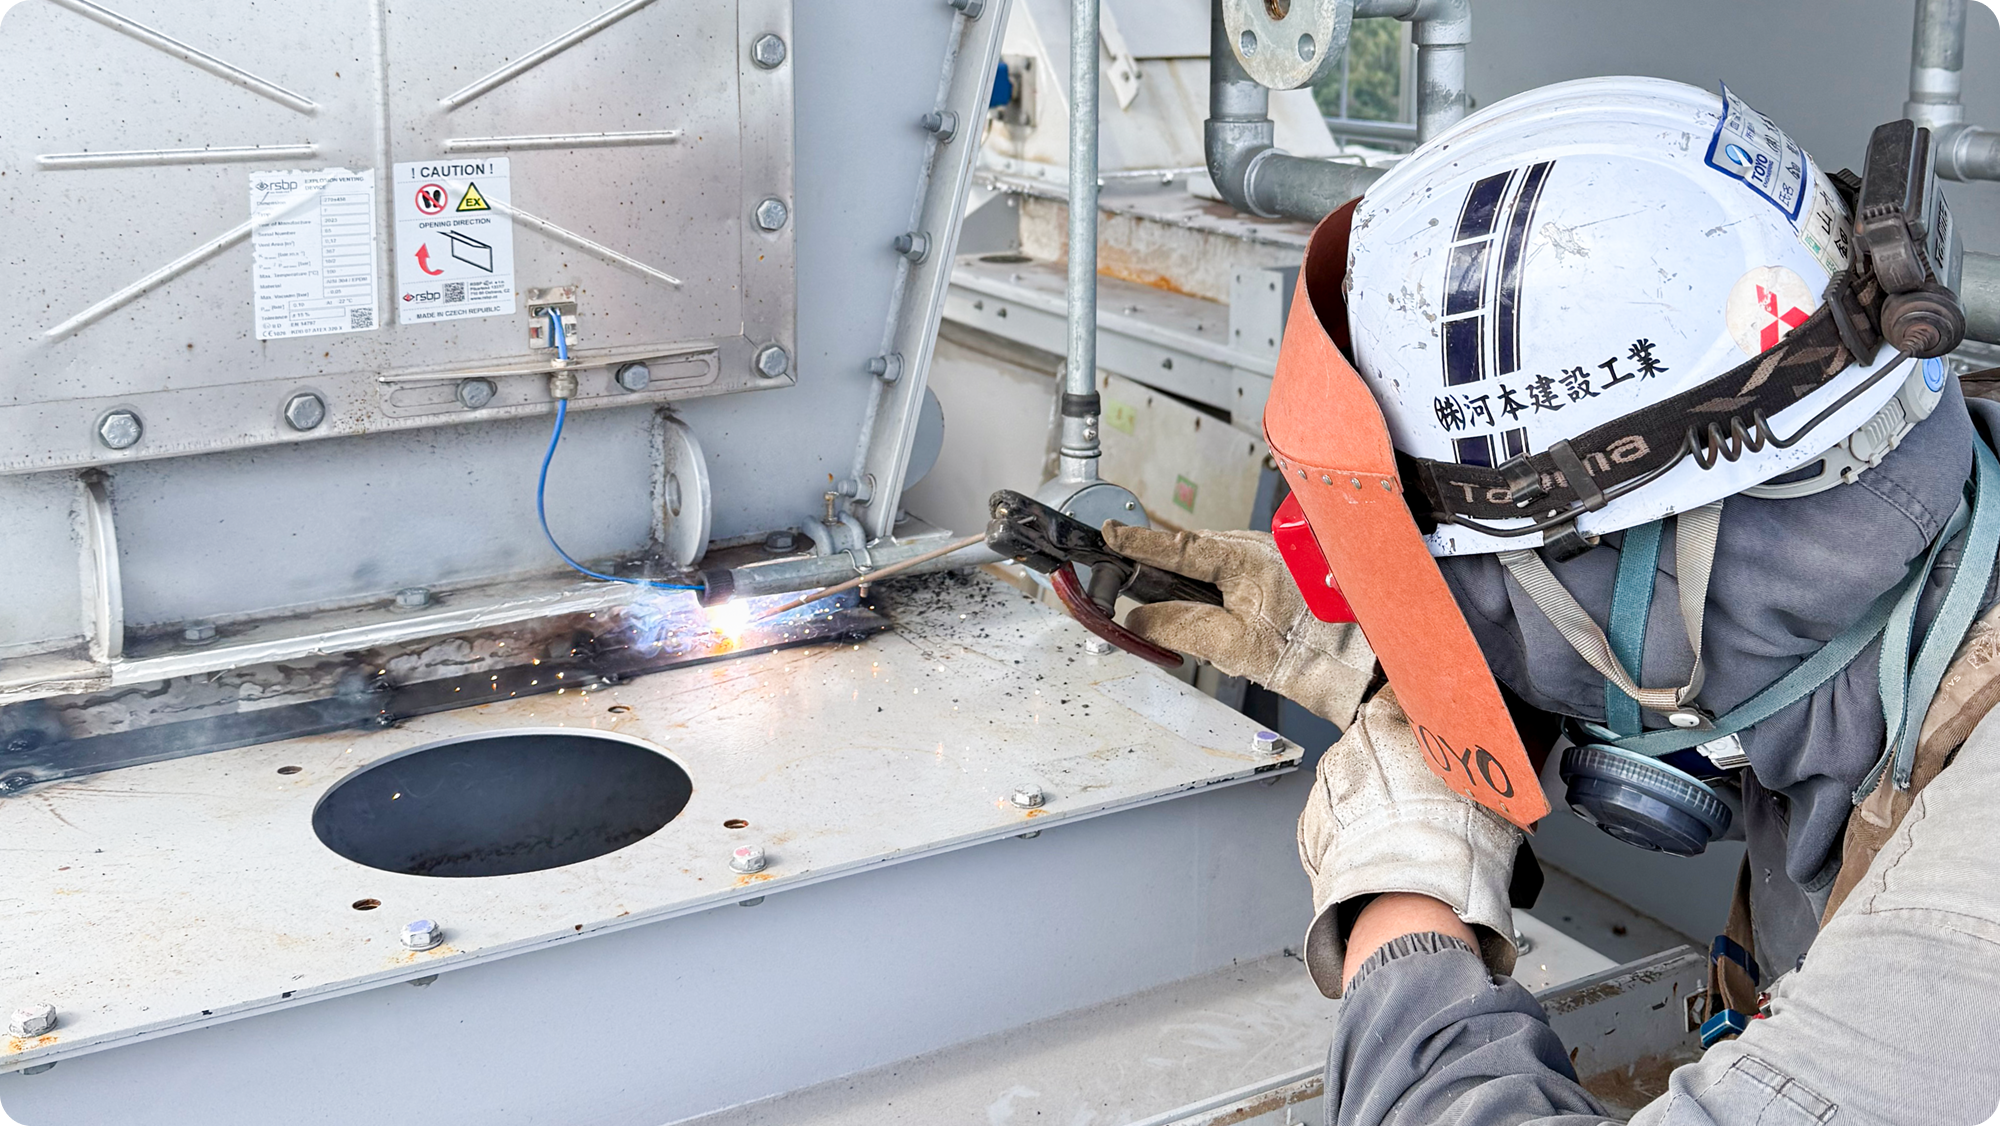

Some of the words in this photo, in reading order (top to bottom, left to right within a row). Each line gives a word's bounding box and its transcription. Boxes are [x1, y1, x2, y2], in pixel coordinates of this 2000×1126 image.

[420, 164, 485, 178] CAUTION
[1751, 153, 1769, 183] TOYO
[269, 179, 298, 191] rsbp
[1778, 182, 1795, 208] 氏名
[465, 198, 481, 207] EX
[419, 220, 452, 229] OPENING
[453, 218, 491, 226] DIRECTION
[415, 290, 441, 301] rsbp
[445, 309, 467, 317] CZECH
[469, 306, 501, 314] REPUBLIC
[1449, 434, 1650, 504] Tama
[1405, 712, 1514, 798] OYO
